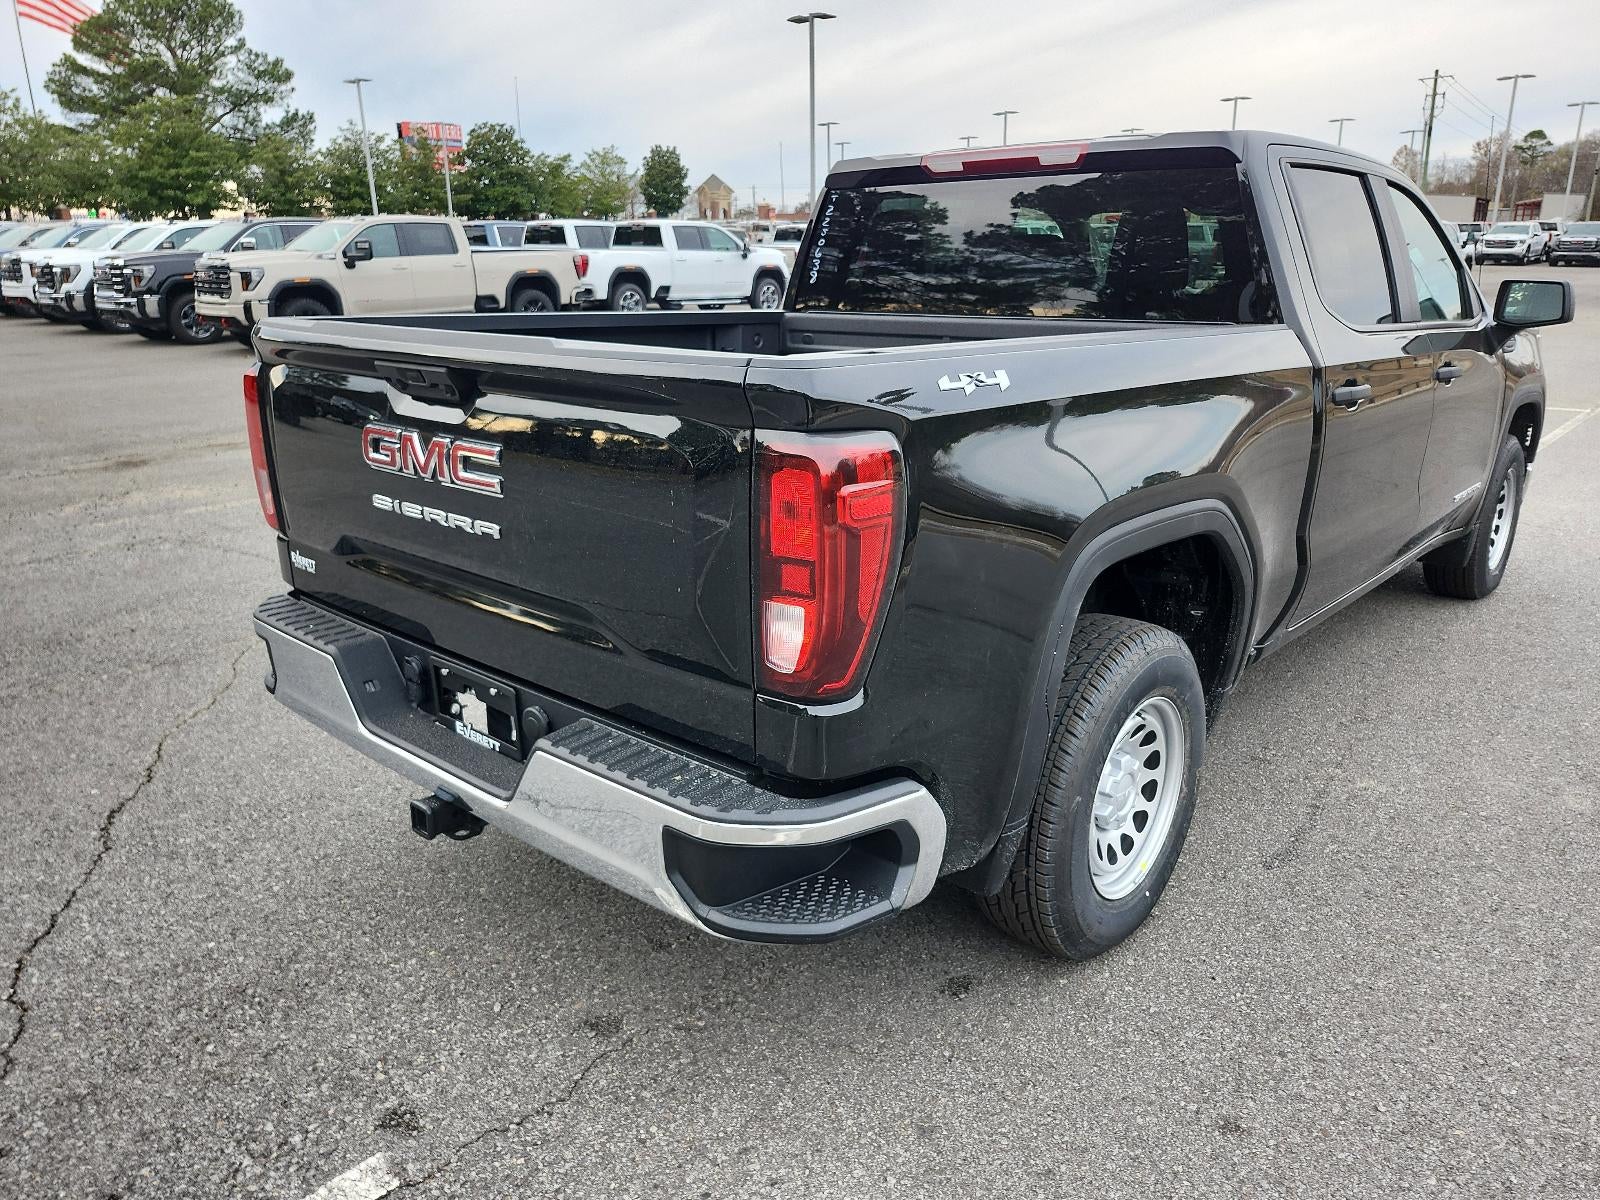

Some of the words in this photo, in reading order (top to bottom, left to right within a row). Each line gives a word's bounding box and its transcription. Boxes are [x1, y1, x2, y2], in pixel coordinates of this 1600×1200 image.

[361, 421, 504, 499] GMC
[371, 493, 502, 540] SIERRA
[455, 720, 501, 752] EVERETT
